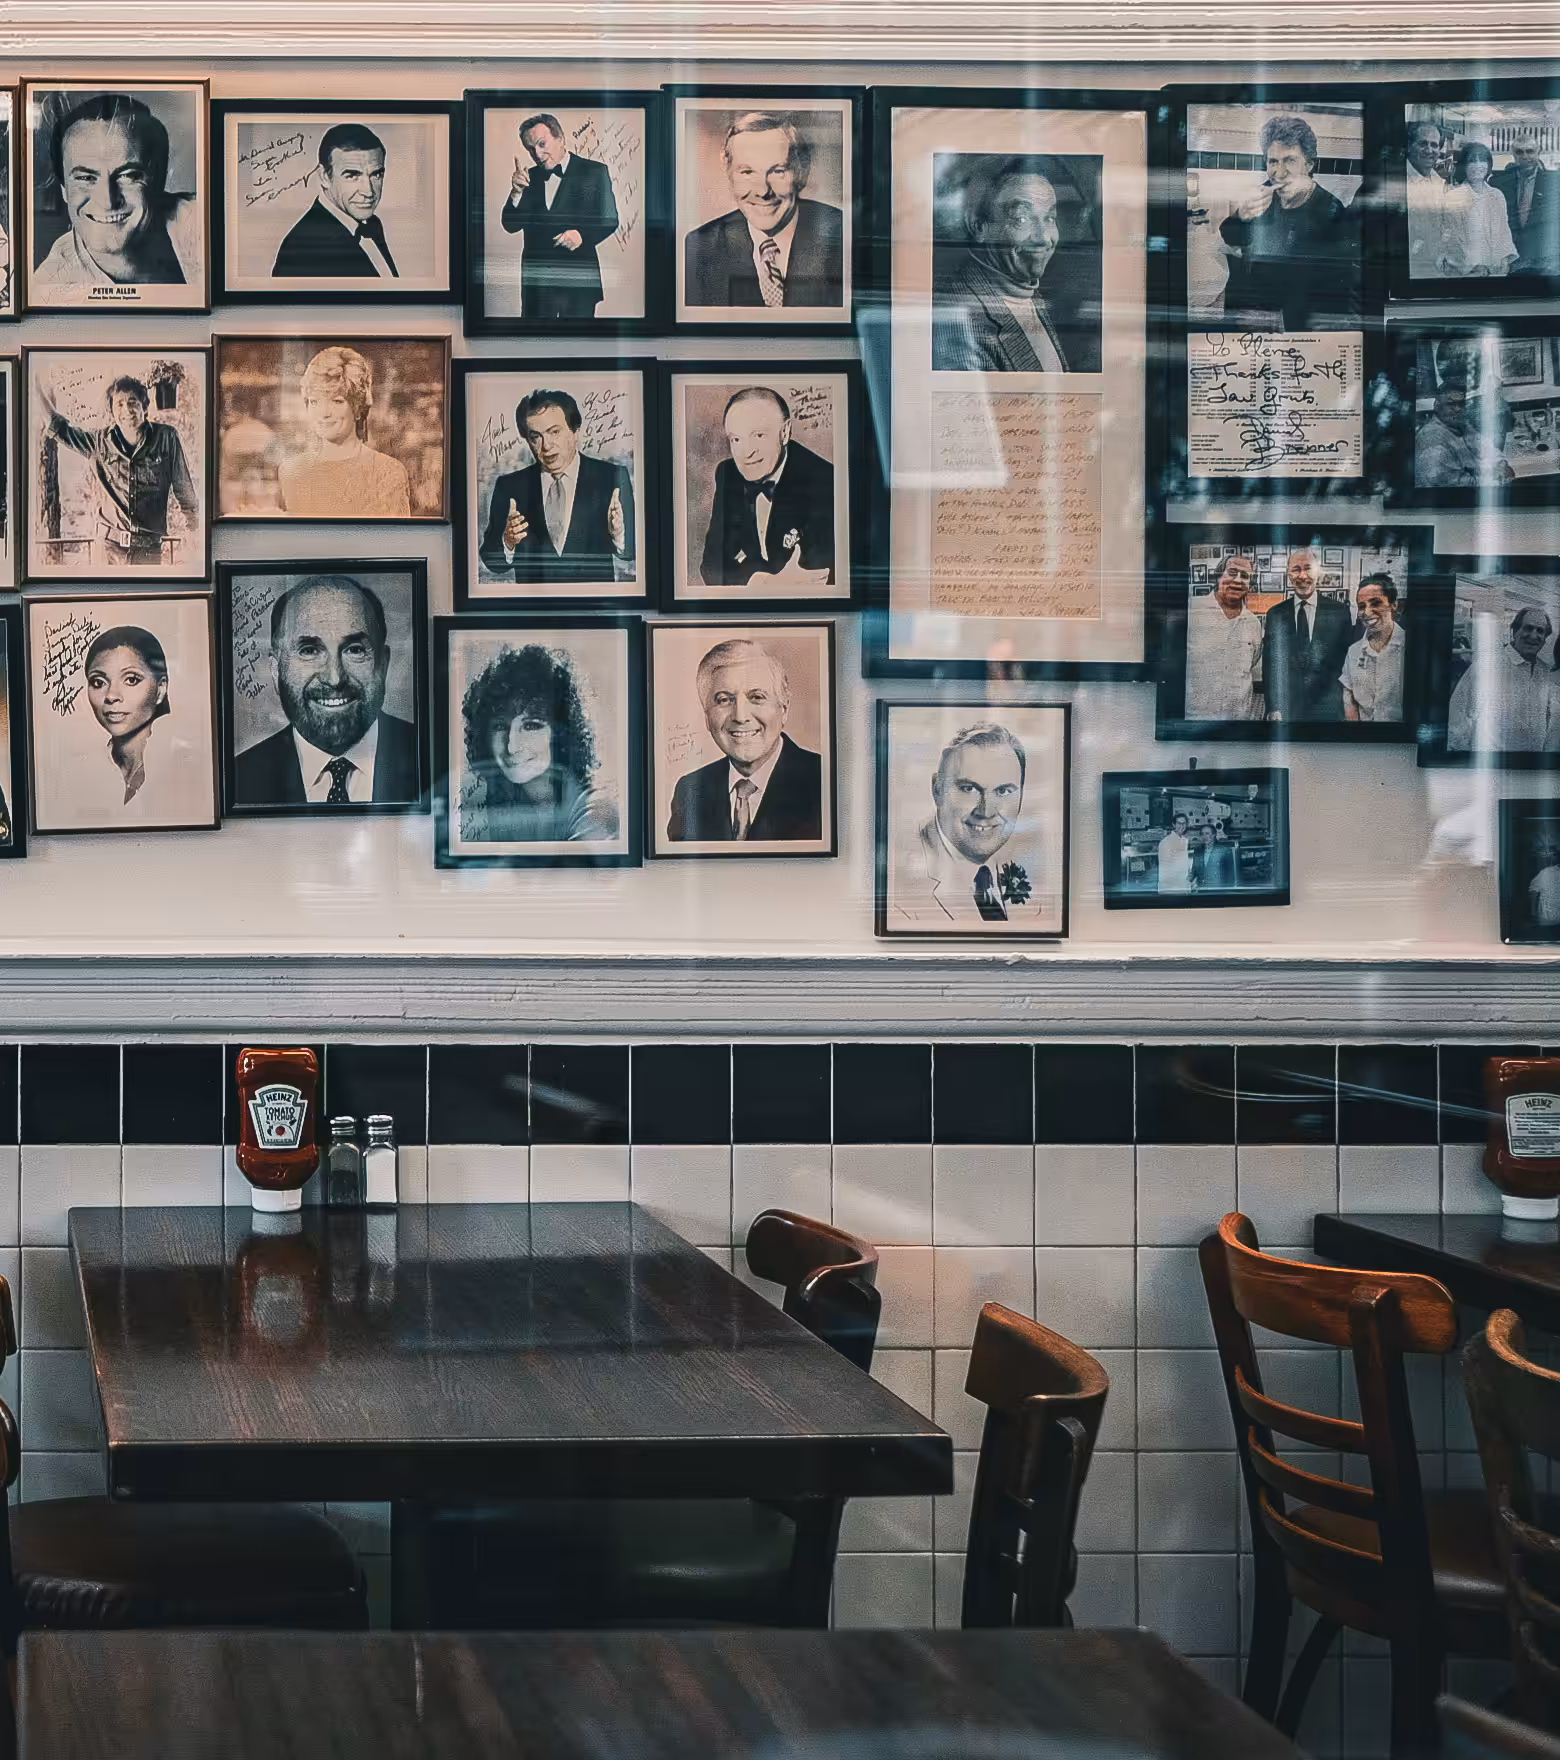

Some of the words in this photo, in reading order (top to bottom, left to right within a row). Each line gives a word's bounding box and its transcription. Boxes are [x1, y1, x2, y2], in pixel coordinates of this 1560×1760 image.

[92, 287, 114, 295] PETER
[266, 1092, 292, 1102] HEINZ
[1524, 1098, 1553, 1110] HEINZ
